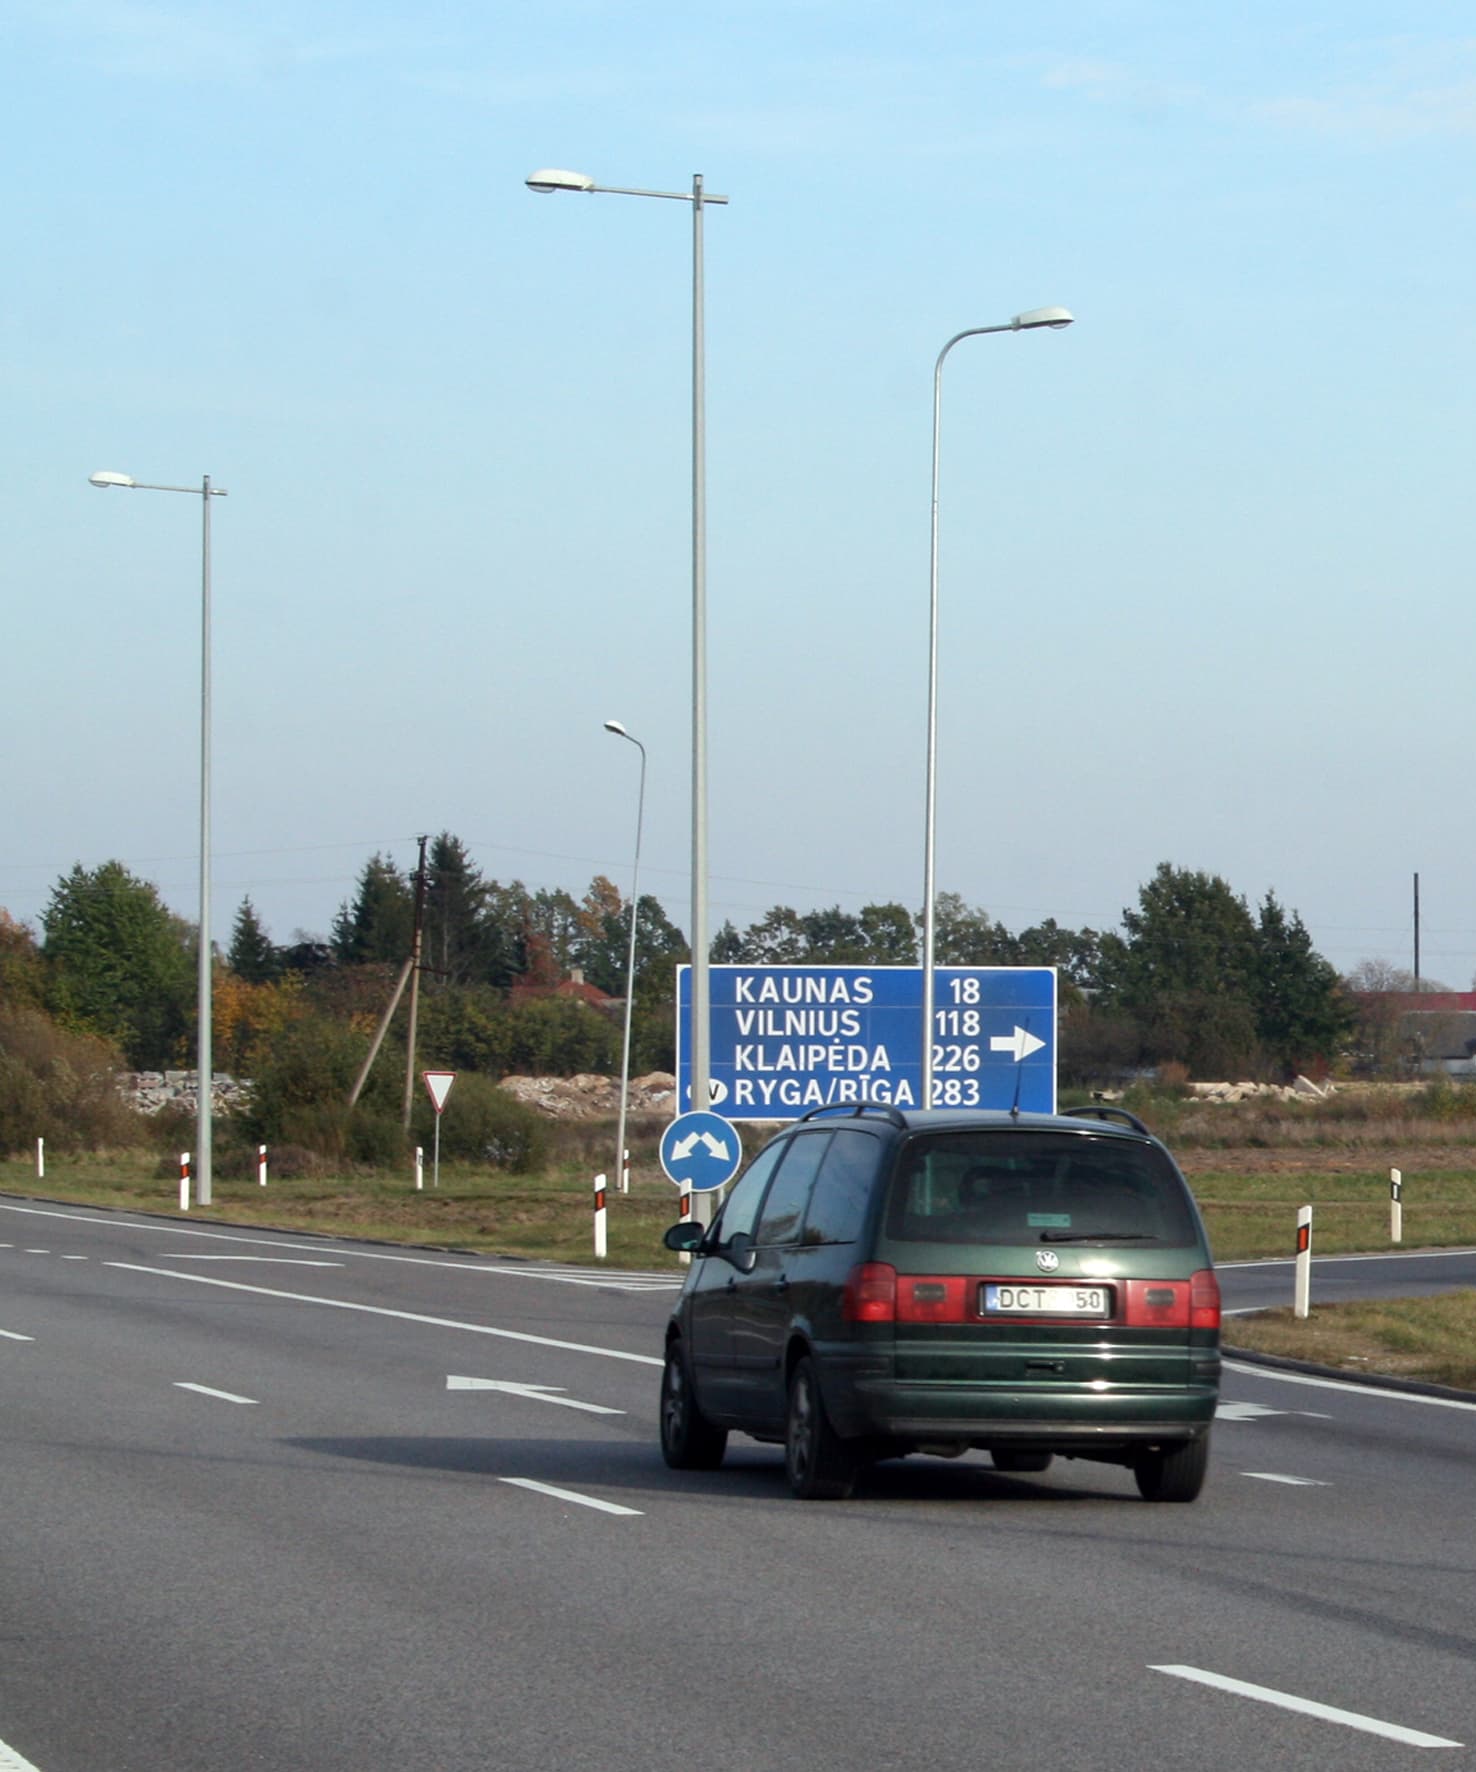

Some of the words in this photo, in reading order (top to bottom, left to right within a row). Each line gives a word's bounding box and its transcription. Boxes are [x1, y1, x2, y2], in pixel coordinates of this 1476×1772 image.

[735, 976, 874, 1004] KAUNAS
[949, 977, 981, 1004] 18
[735, 1009, 861, 1037] VILNIUS
[936, 1010, 981, 1037] 118
[735, 1037, 891, 1072] KLAIPĖDA
[932, 1044, 981, 1072] 226
[735, 1074, 915, 1106] RYGA/RĪGA
[932, 1078, 981, 1106] 283
[1000, 1289, 1046, 1309] DCT
